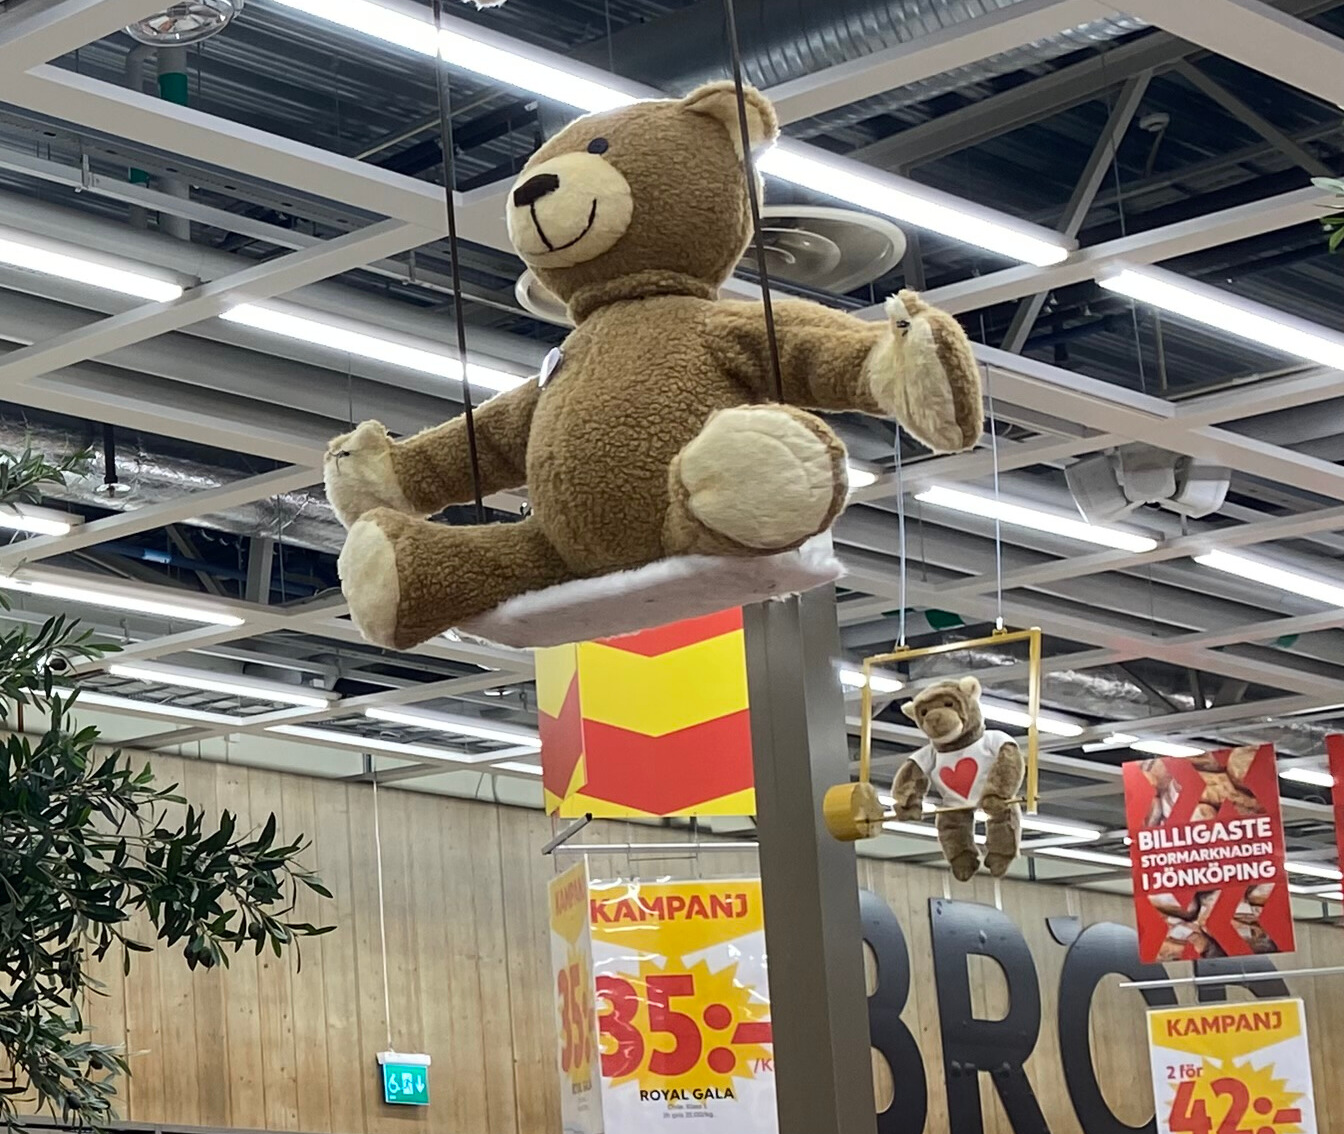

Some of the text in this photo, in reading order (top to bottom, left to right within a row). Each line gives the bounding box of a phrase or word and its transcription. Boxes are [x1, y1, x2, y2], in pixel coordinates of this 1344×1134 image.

[1138, 818, 1273, 851] BILLIGASTE
[1141, 842, 1274, 868] STORMARKNADEN
[1142, 860, 1277, 890] I JÖNKÖPING
[591, 893, 748, 923] KAMPANJ
[1166, 1011, 1283, 1037] KAMPANJ
[1166, 1063, 1204, 1079] 2 för
[639, 1087, 735, 1102] ROYAL GALA
